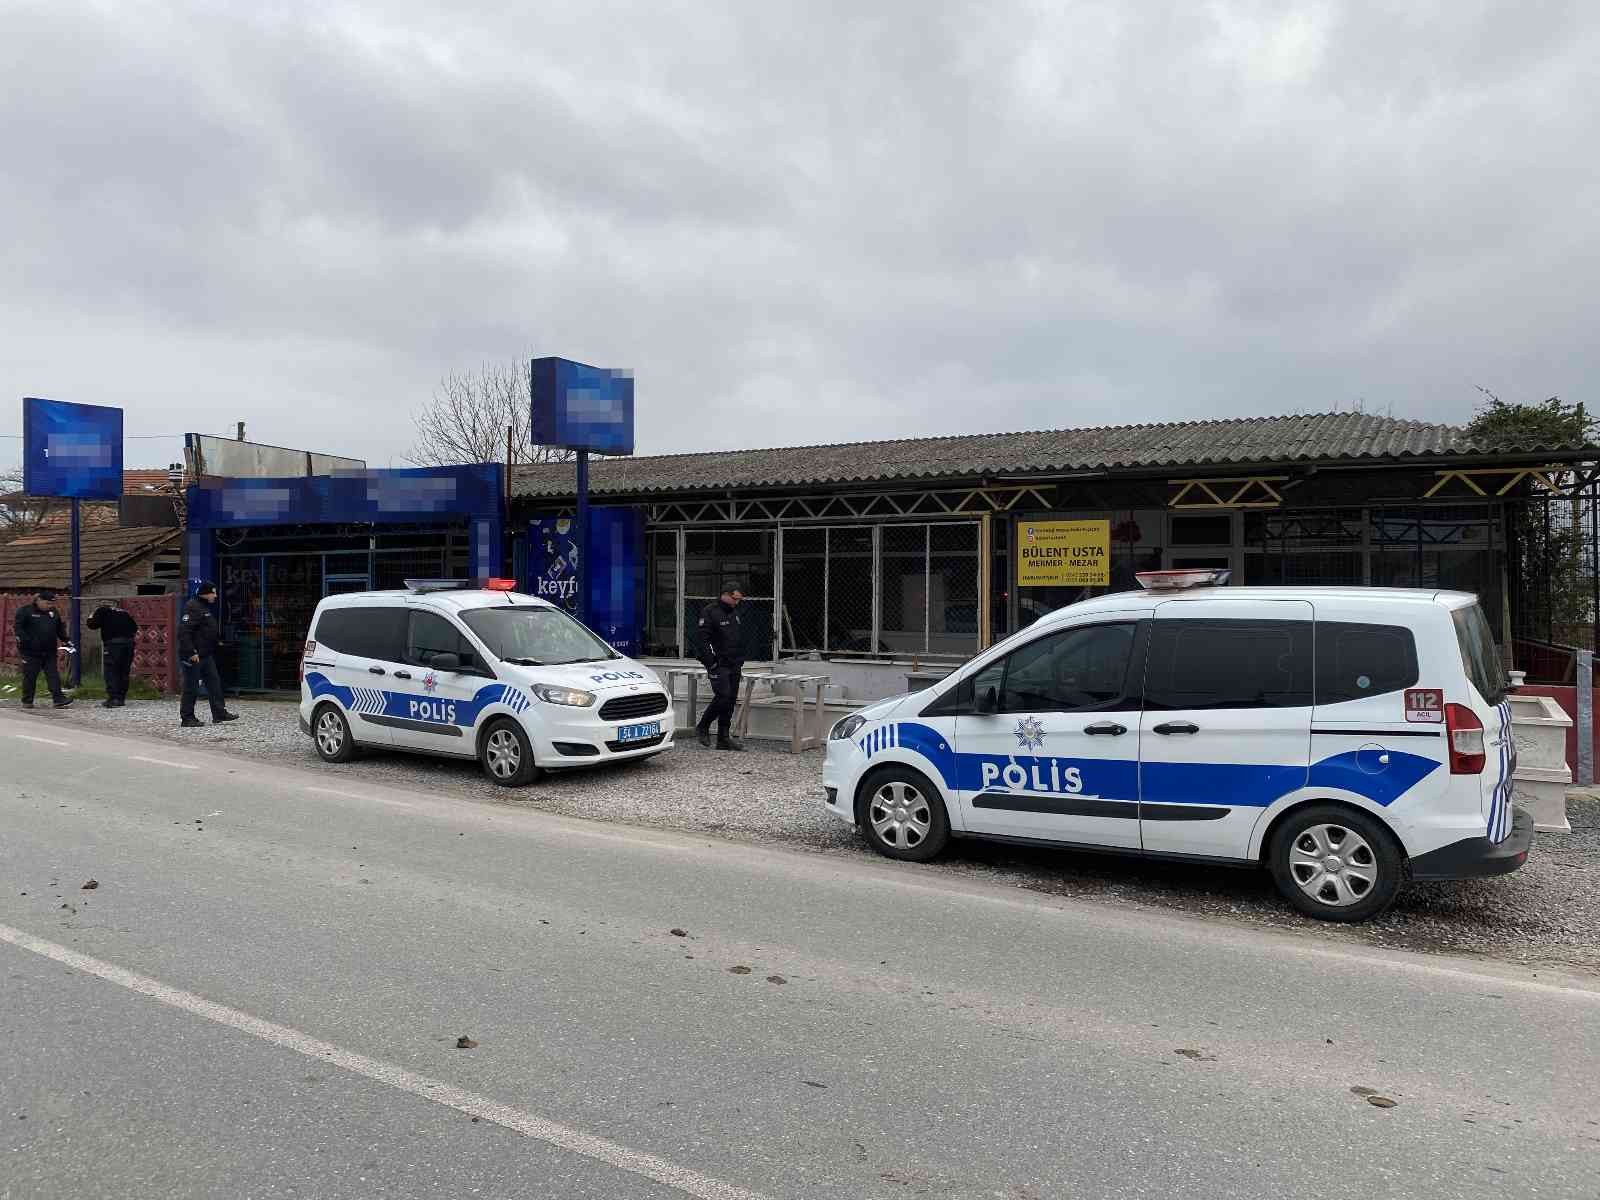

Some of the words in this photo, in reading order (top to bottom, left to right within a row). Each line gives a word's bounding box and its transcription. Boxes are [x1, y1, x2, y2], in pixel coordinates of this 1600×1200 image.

[1022, 546, 1070, 558] BÜLENT
[1072, 547, 1104, 557] USTA
[537, 576, 578, 599] keyf
[410, 699, 456, 721] POLİS
[1410, 692, 1438, 708] 112
[981, 758, 1083, 793] POLİS
